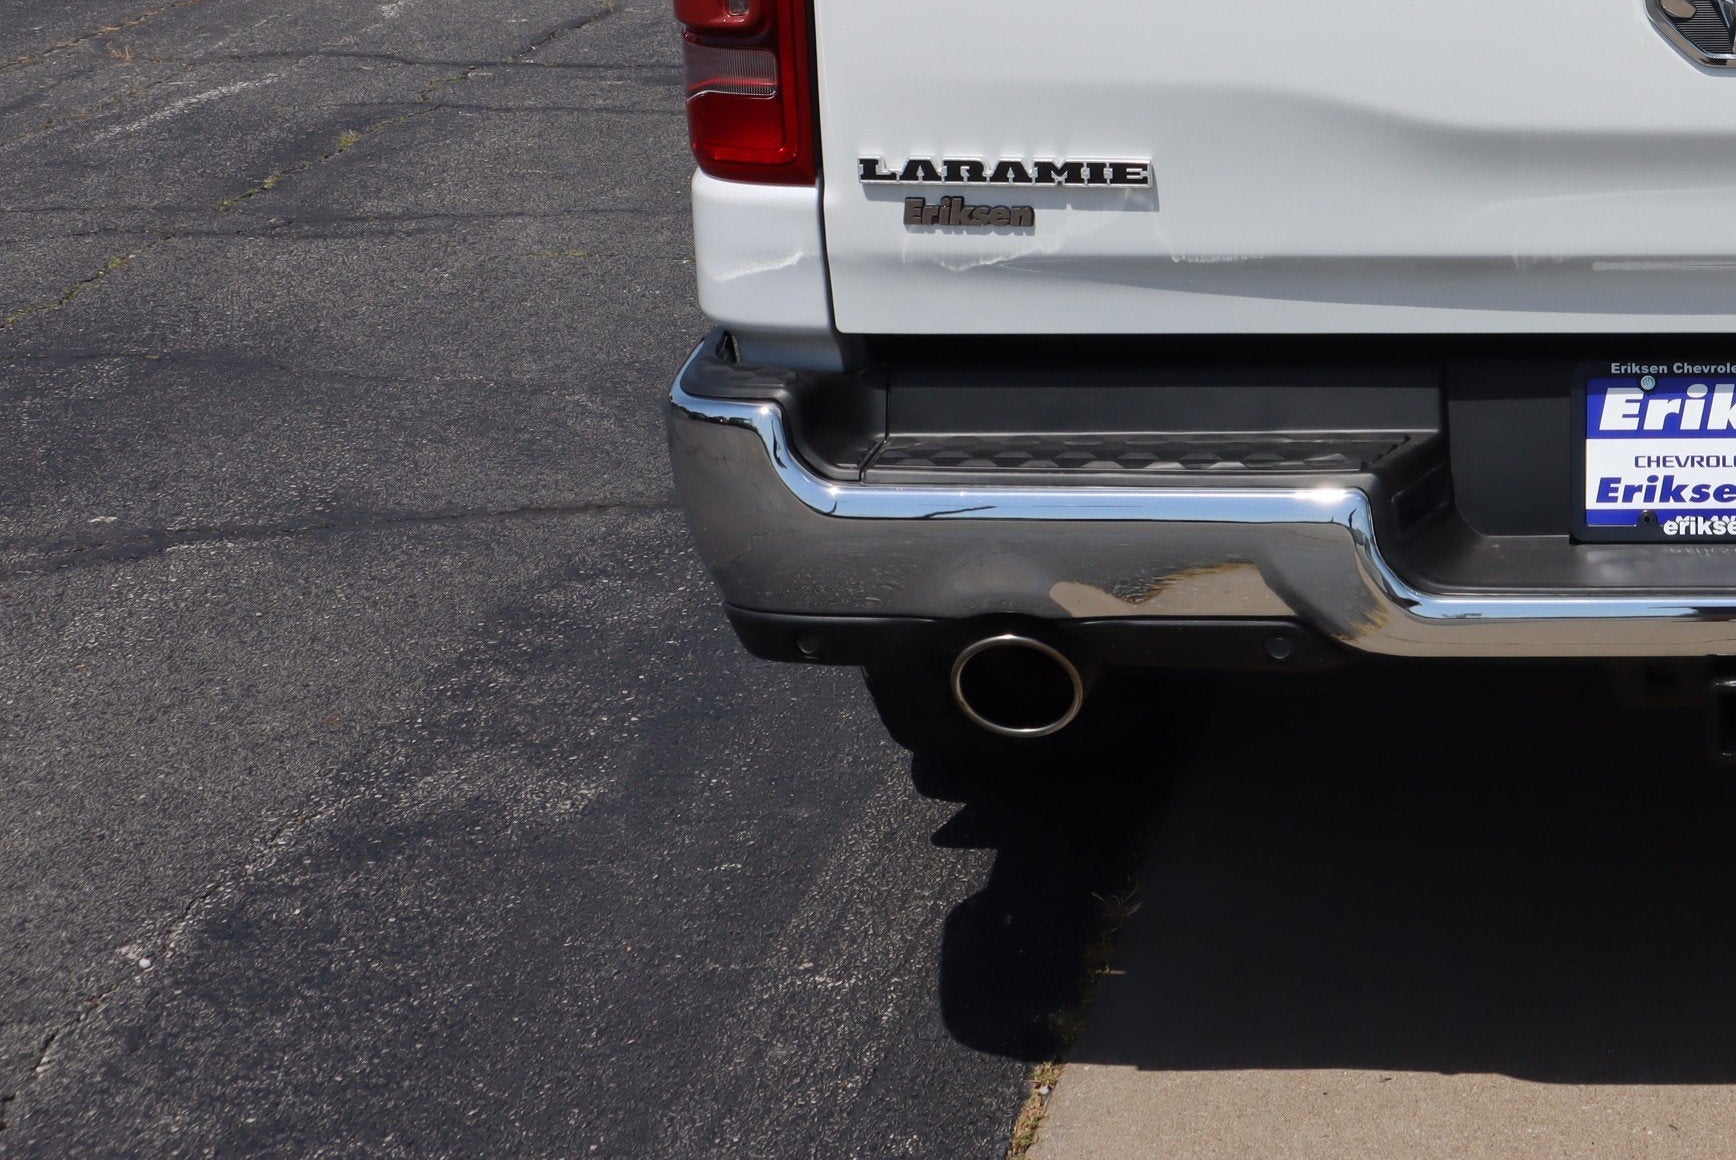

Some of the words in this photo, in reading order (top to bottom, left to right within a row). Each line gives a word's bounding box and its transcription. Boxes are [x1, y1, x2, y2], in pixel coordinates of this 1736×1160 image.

[857, 156, 1152, 187] LARAMIE
[904, 196, 1036, 226] Eriksen
[1610, 362, 1668, 374] Eriksen
